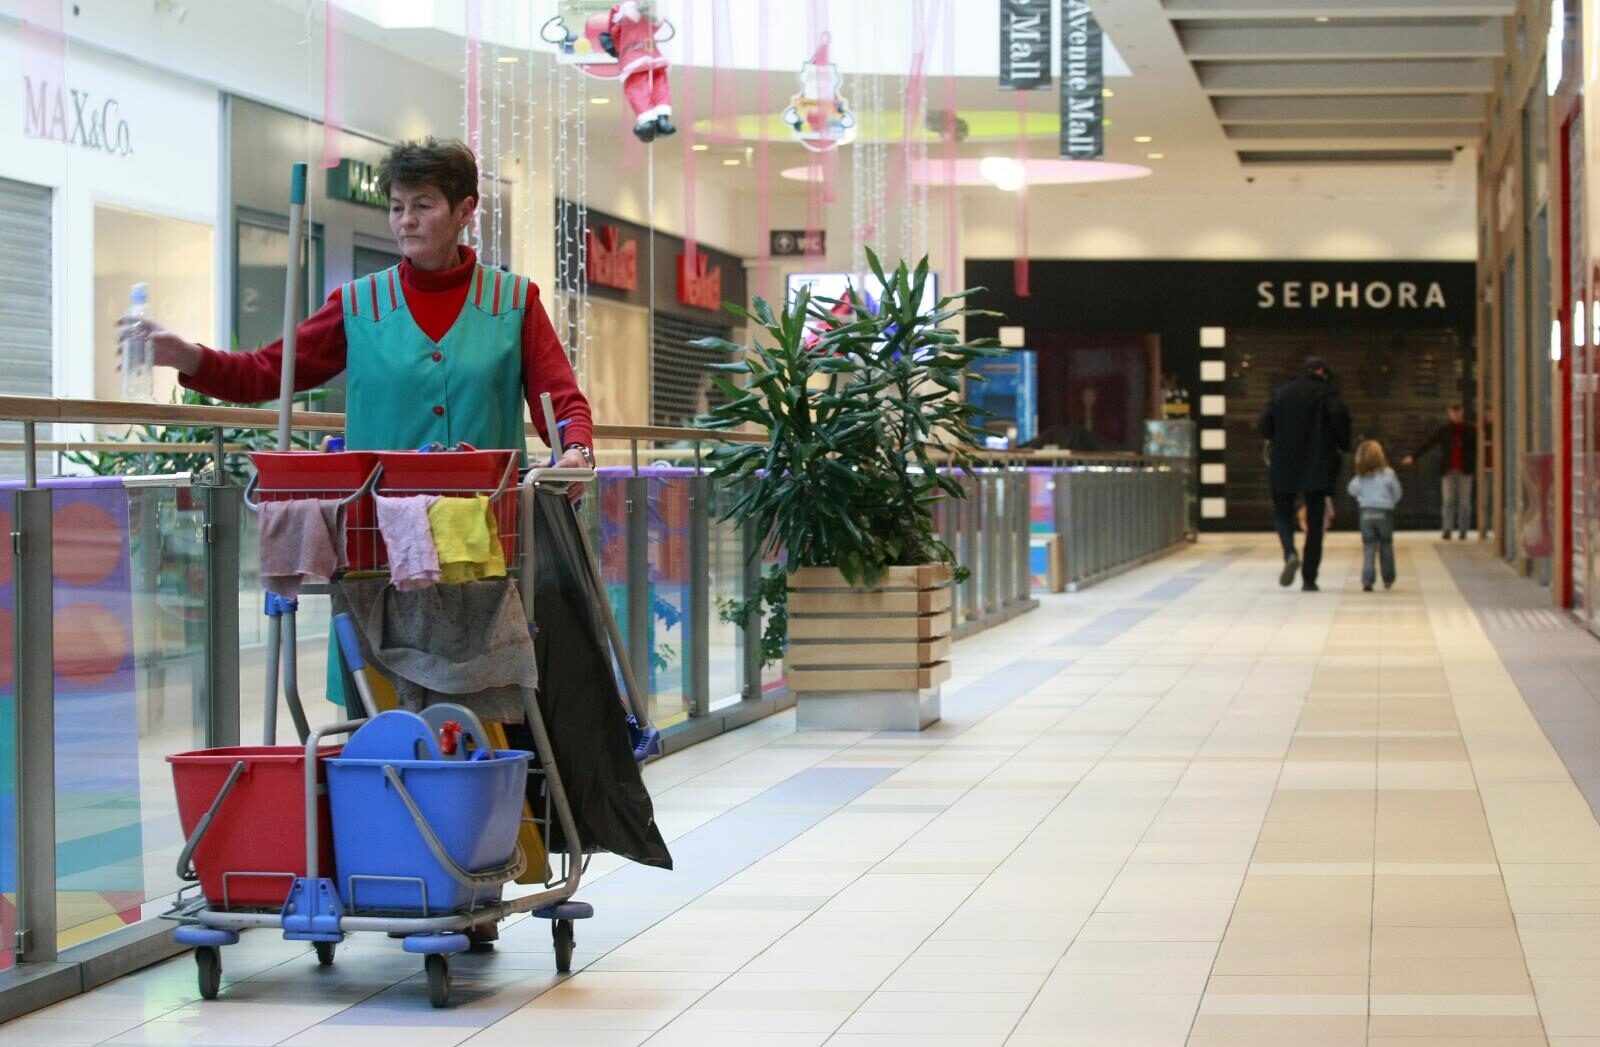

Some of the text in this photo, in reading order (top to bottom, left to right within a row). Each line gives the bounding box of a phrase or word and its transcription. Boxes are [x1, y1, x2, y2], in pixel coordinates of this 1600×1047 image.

[1010, 12, 1041, 80] Mall
[1068, 0, 1095, 153] Avenue Mall
[796, 237, 821, 251] WC
[1257, 281, 1447, 309] SEPHORA
